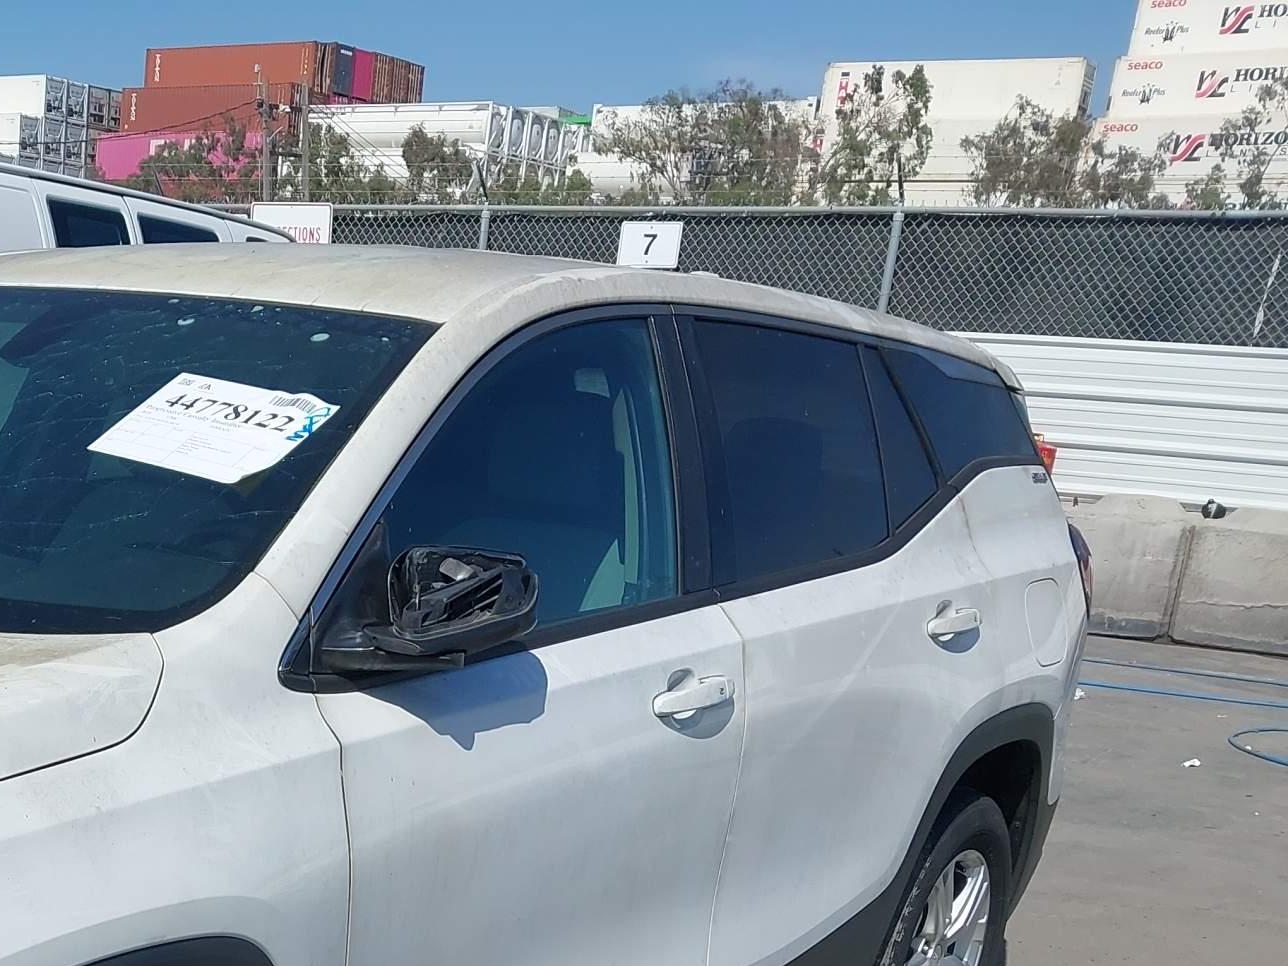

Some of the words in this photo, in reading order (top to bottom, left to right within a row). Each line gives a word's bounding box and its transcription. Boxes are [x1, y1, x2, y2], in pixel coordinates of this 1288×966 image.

[1257, 3, 1288, 18] HO
[1127, 60, 1163, 71] seaco
[1103, 123, 1138, 133] seaco
[643, 233, 658, 256] 7
[164, 393, 296, 432] 44778122
